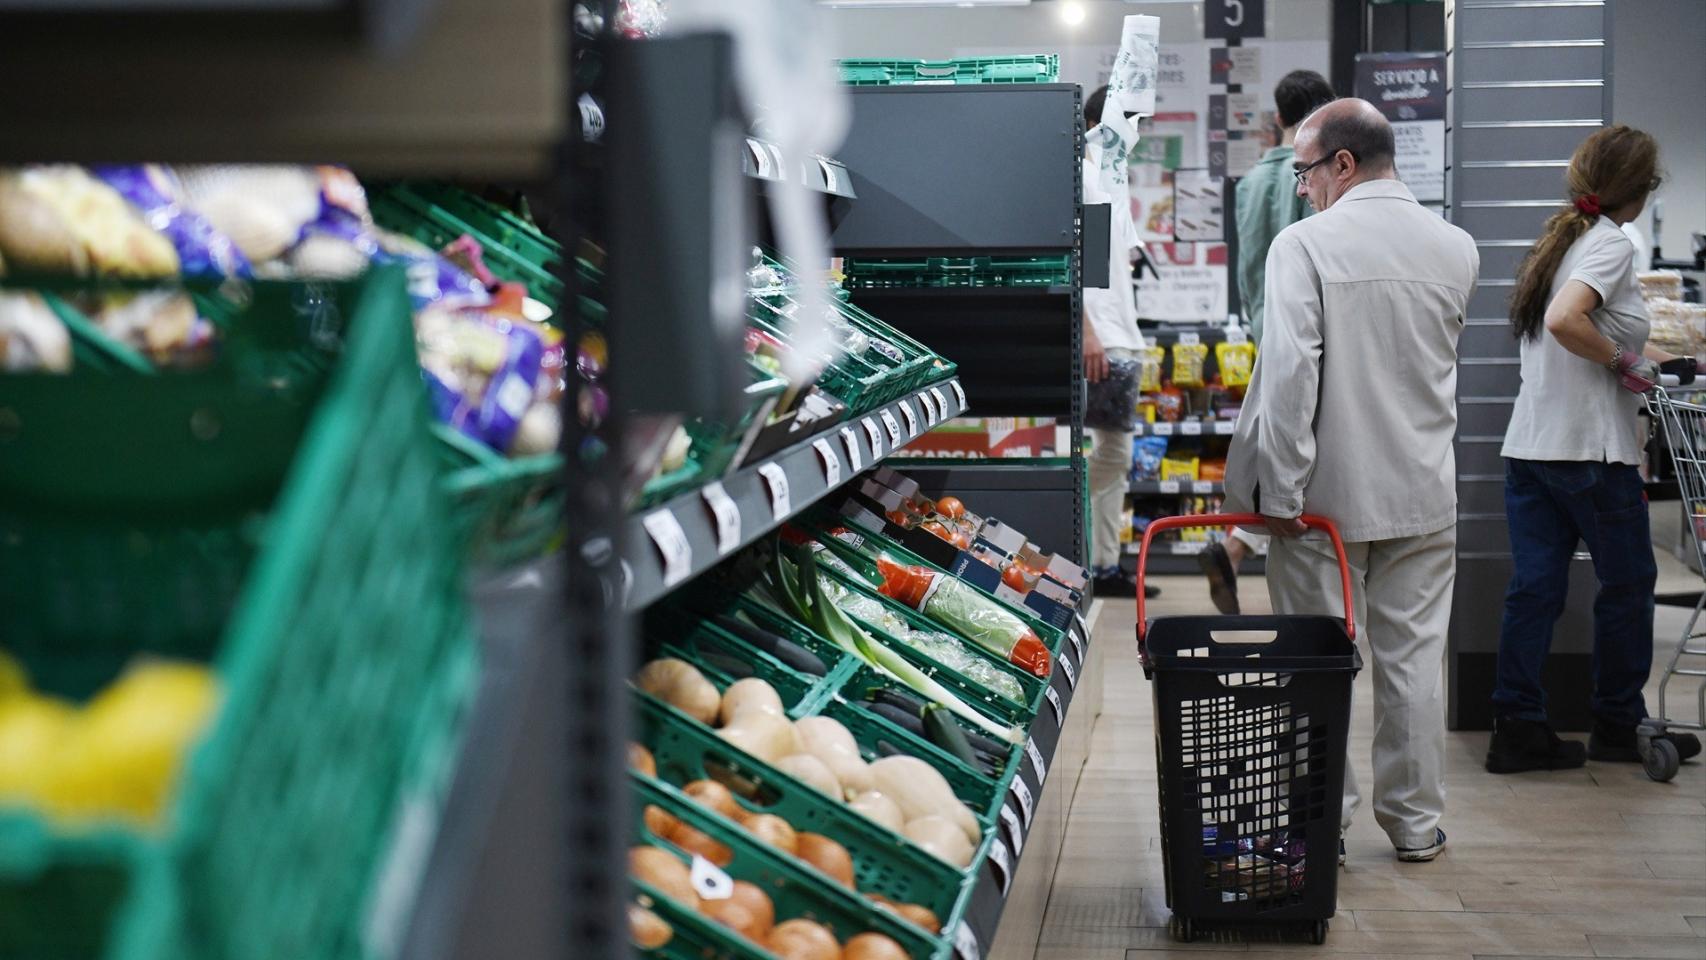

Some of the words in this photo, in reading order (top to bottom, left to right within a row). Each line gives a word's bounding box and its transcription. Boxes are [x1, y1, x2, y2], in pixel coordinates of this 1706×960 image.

[1224, 0, 1244, 27] 5
[1373, 69, 1427, 86] SERVICIO
[1429, 67, 1440, 83] A
